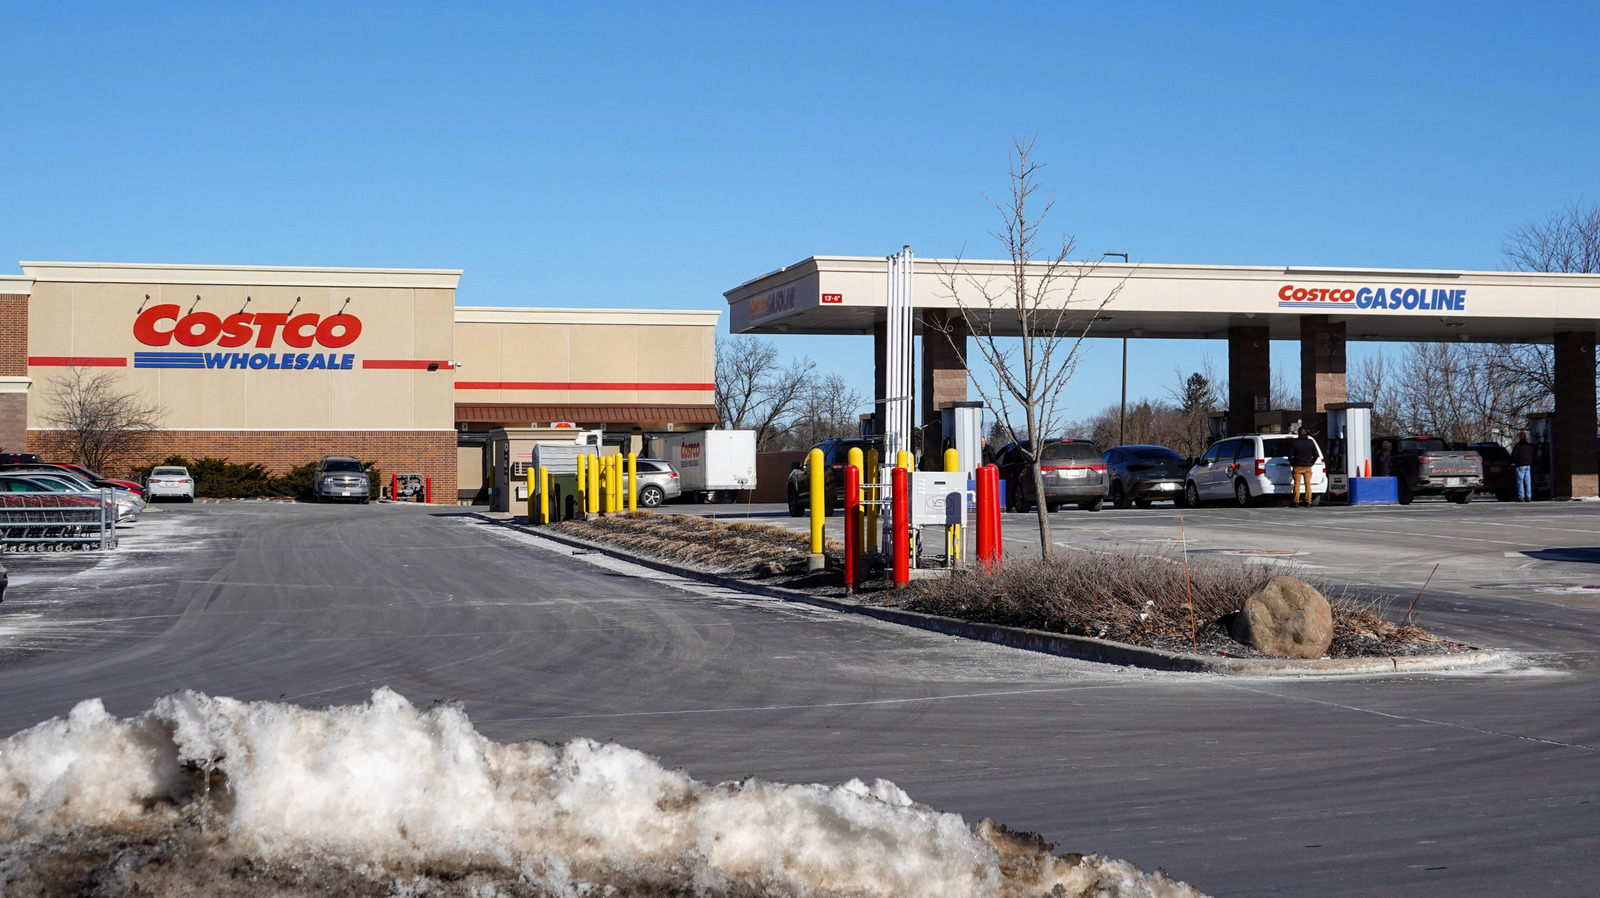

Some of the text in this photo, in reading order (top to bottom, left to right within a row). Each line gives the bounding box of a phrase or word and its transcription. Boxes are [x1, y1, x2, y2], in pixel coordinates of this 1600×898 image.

[1278, 285, 1466, 310] COSTCO GASOLINE
[133, 303, 362, 348] COSTCO
[204, 353, 355, 370] WHOLESALE
[681, 441, 699, 459] COSTCO
